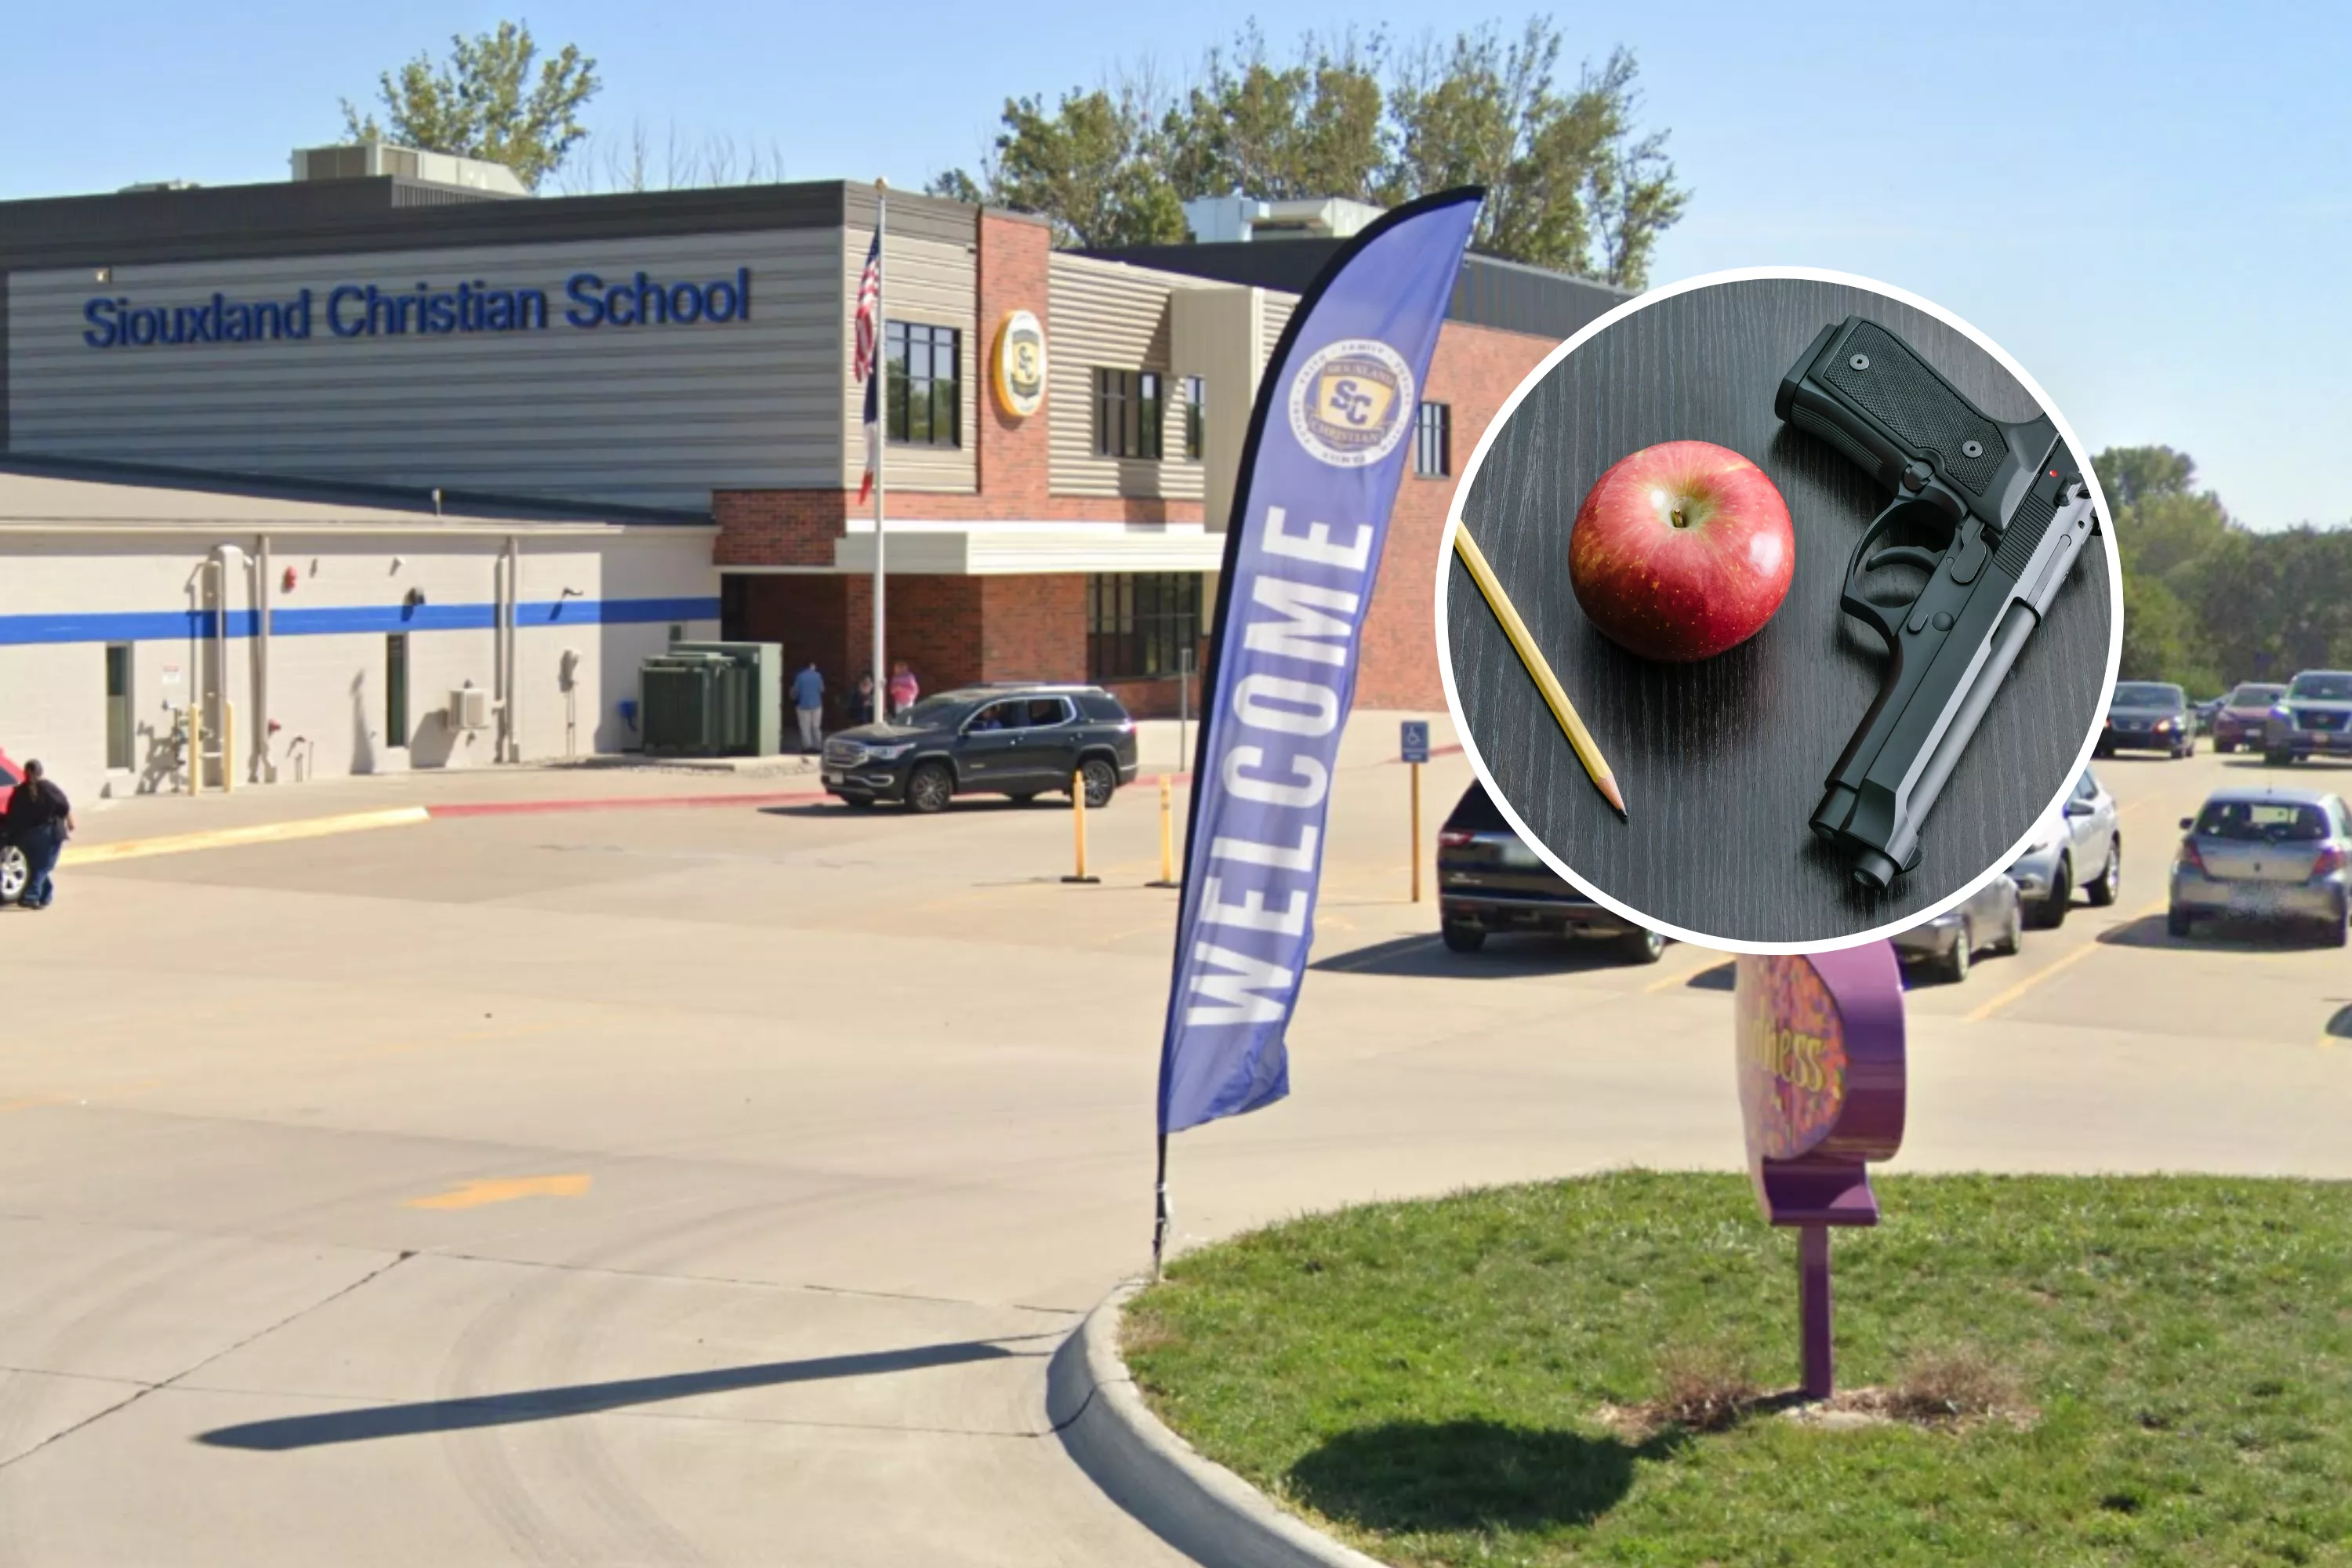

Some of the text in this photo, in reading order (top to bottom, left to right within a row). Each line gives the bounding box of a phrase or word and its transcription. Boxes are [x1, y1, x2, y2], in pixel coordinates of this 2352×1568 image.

[82, 267, 751, 350] Siouxland Christian School
[1188, 506, 1373, 1027] WELCOME
